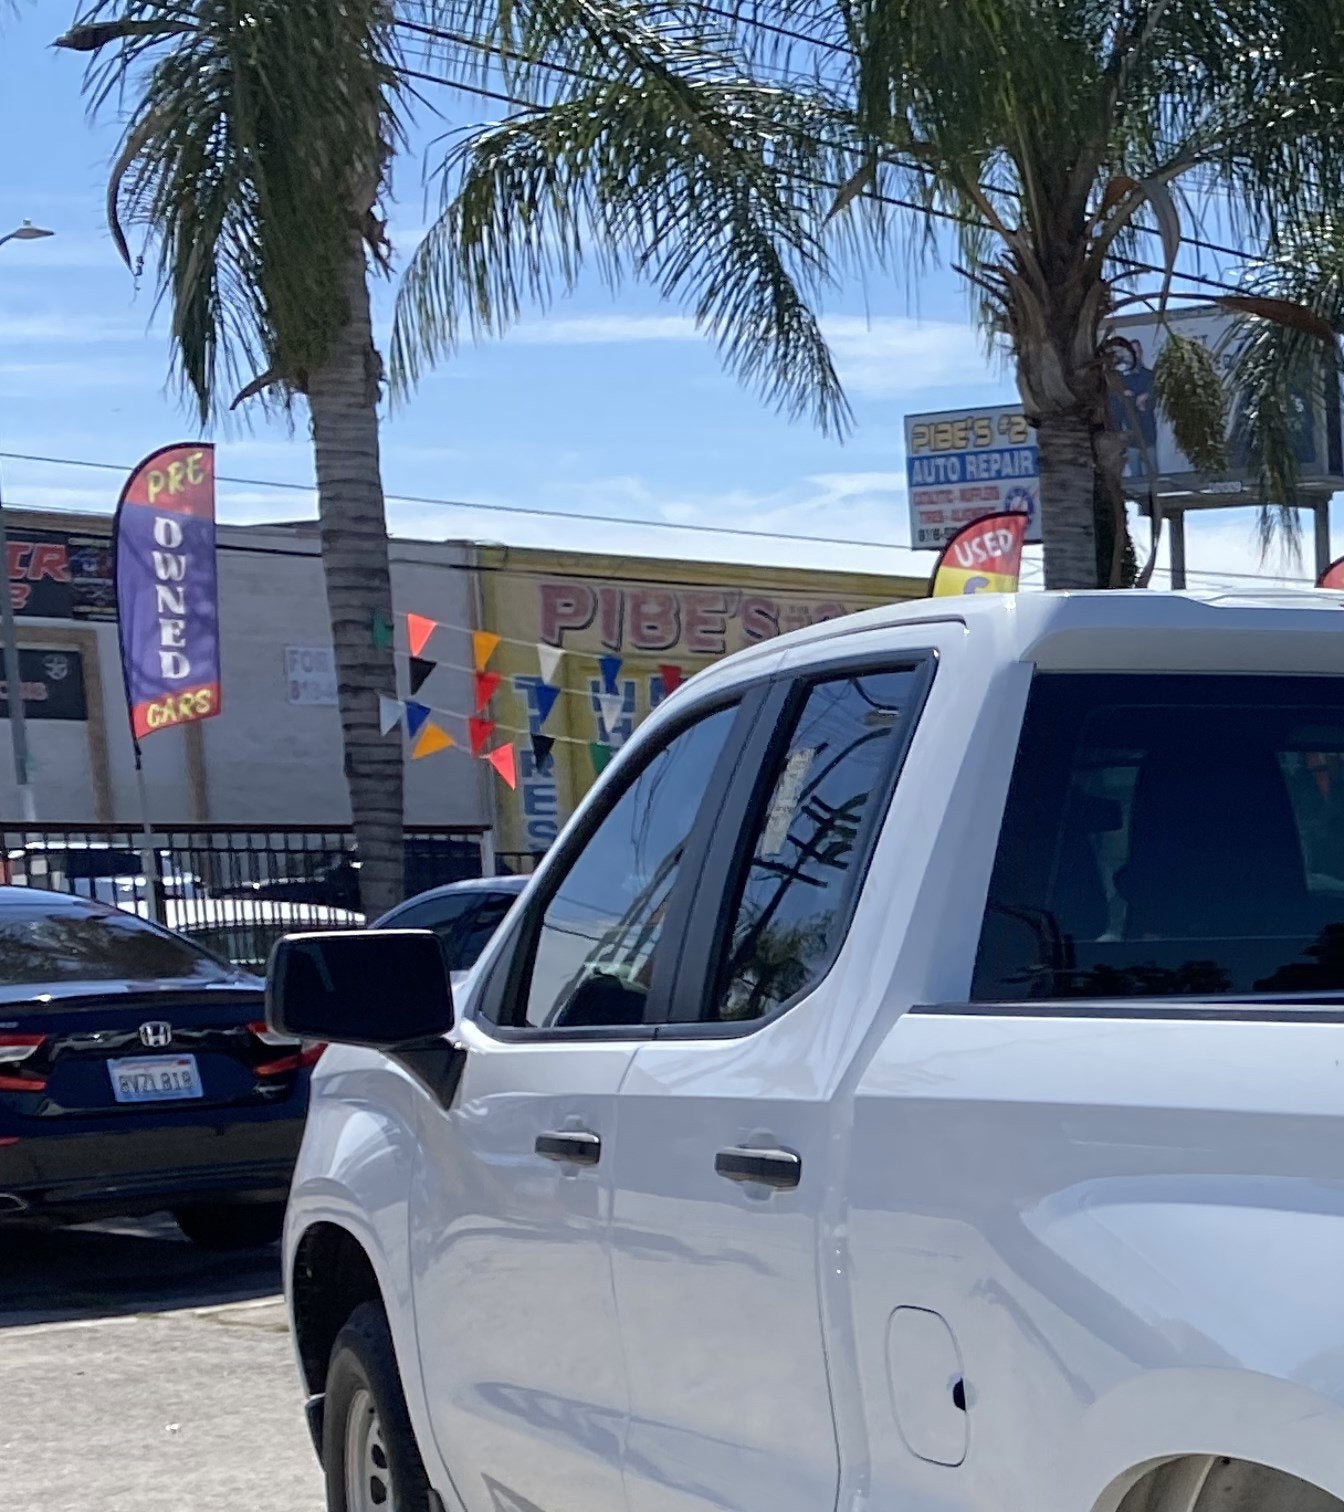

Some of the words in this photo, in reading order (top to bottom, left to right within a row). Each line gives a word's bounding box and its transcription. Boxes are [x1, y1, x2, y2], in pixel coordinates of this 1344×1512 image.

[147, 452, 206, 504] PRE
[911, 457, 961, 485] AUTO
[965, 450, 1035, 480] REPAIR
[954, 528, 1013, 568] USED
[151, 516, 191, 680] OWNED
[539, 582, 780, 653] PIBE'S
[146, 689, 212, 729] CARS
